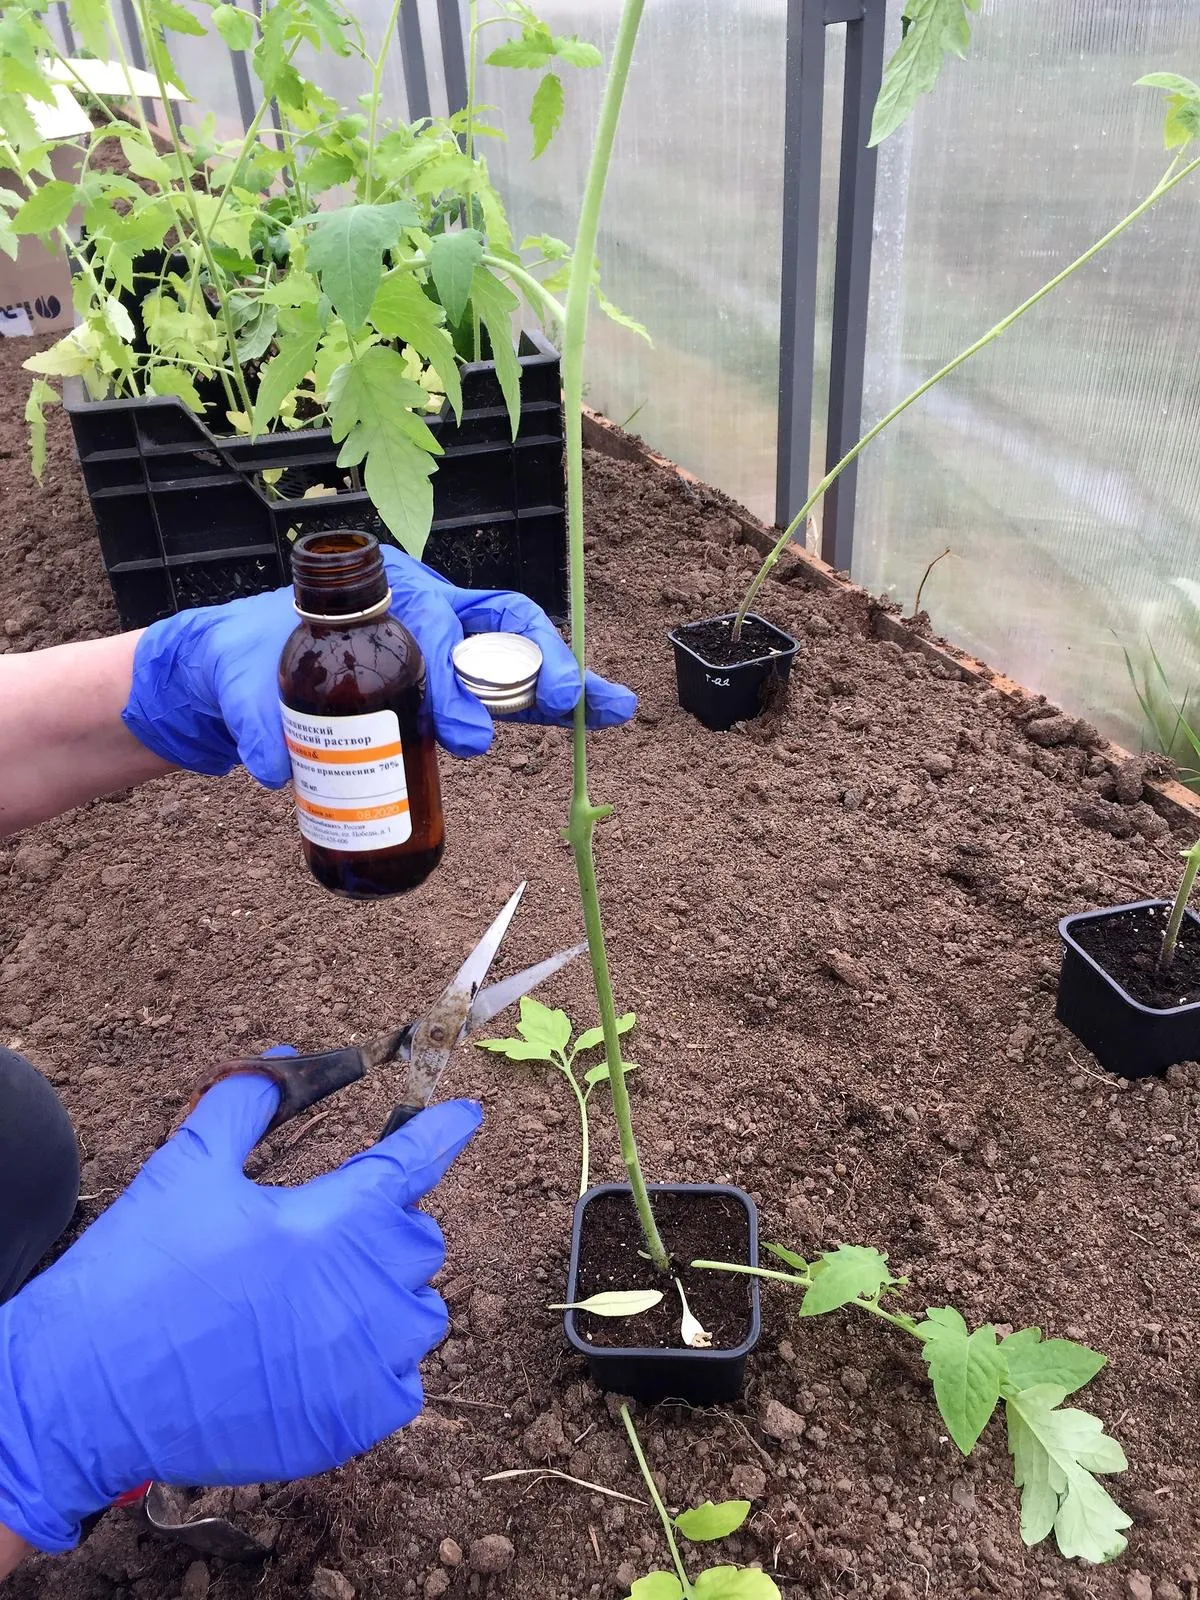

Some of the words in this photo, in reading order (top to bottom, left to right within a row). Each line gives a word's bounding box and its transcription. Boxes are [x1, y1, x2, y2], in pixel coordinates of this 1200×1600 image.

[324, 735, 372, 748] раствор
[317, 766, 376, 777] применения
[379, 760, 400, 772] 70%
[344, 823, 366, 831] Россия
